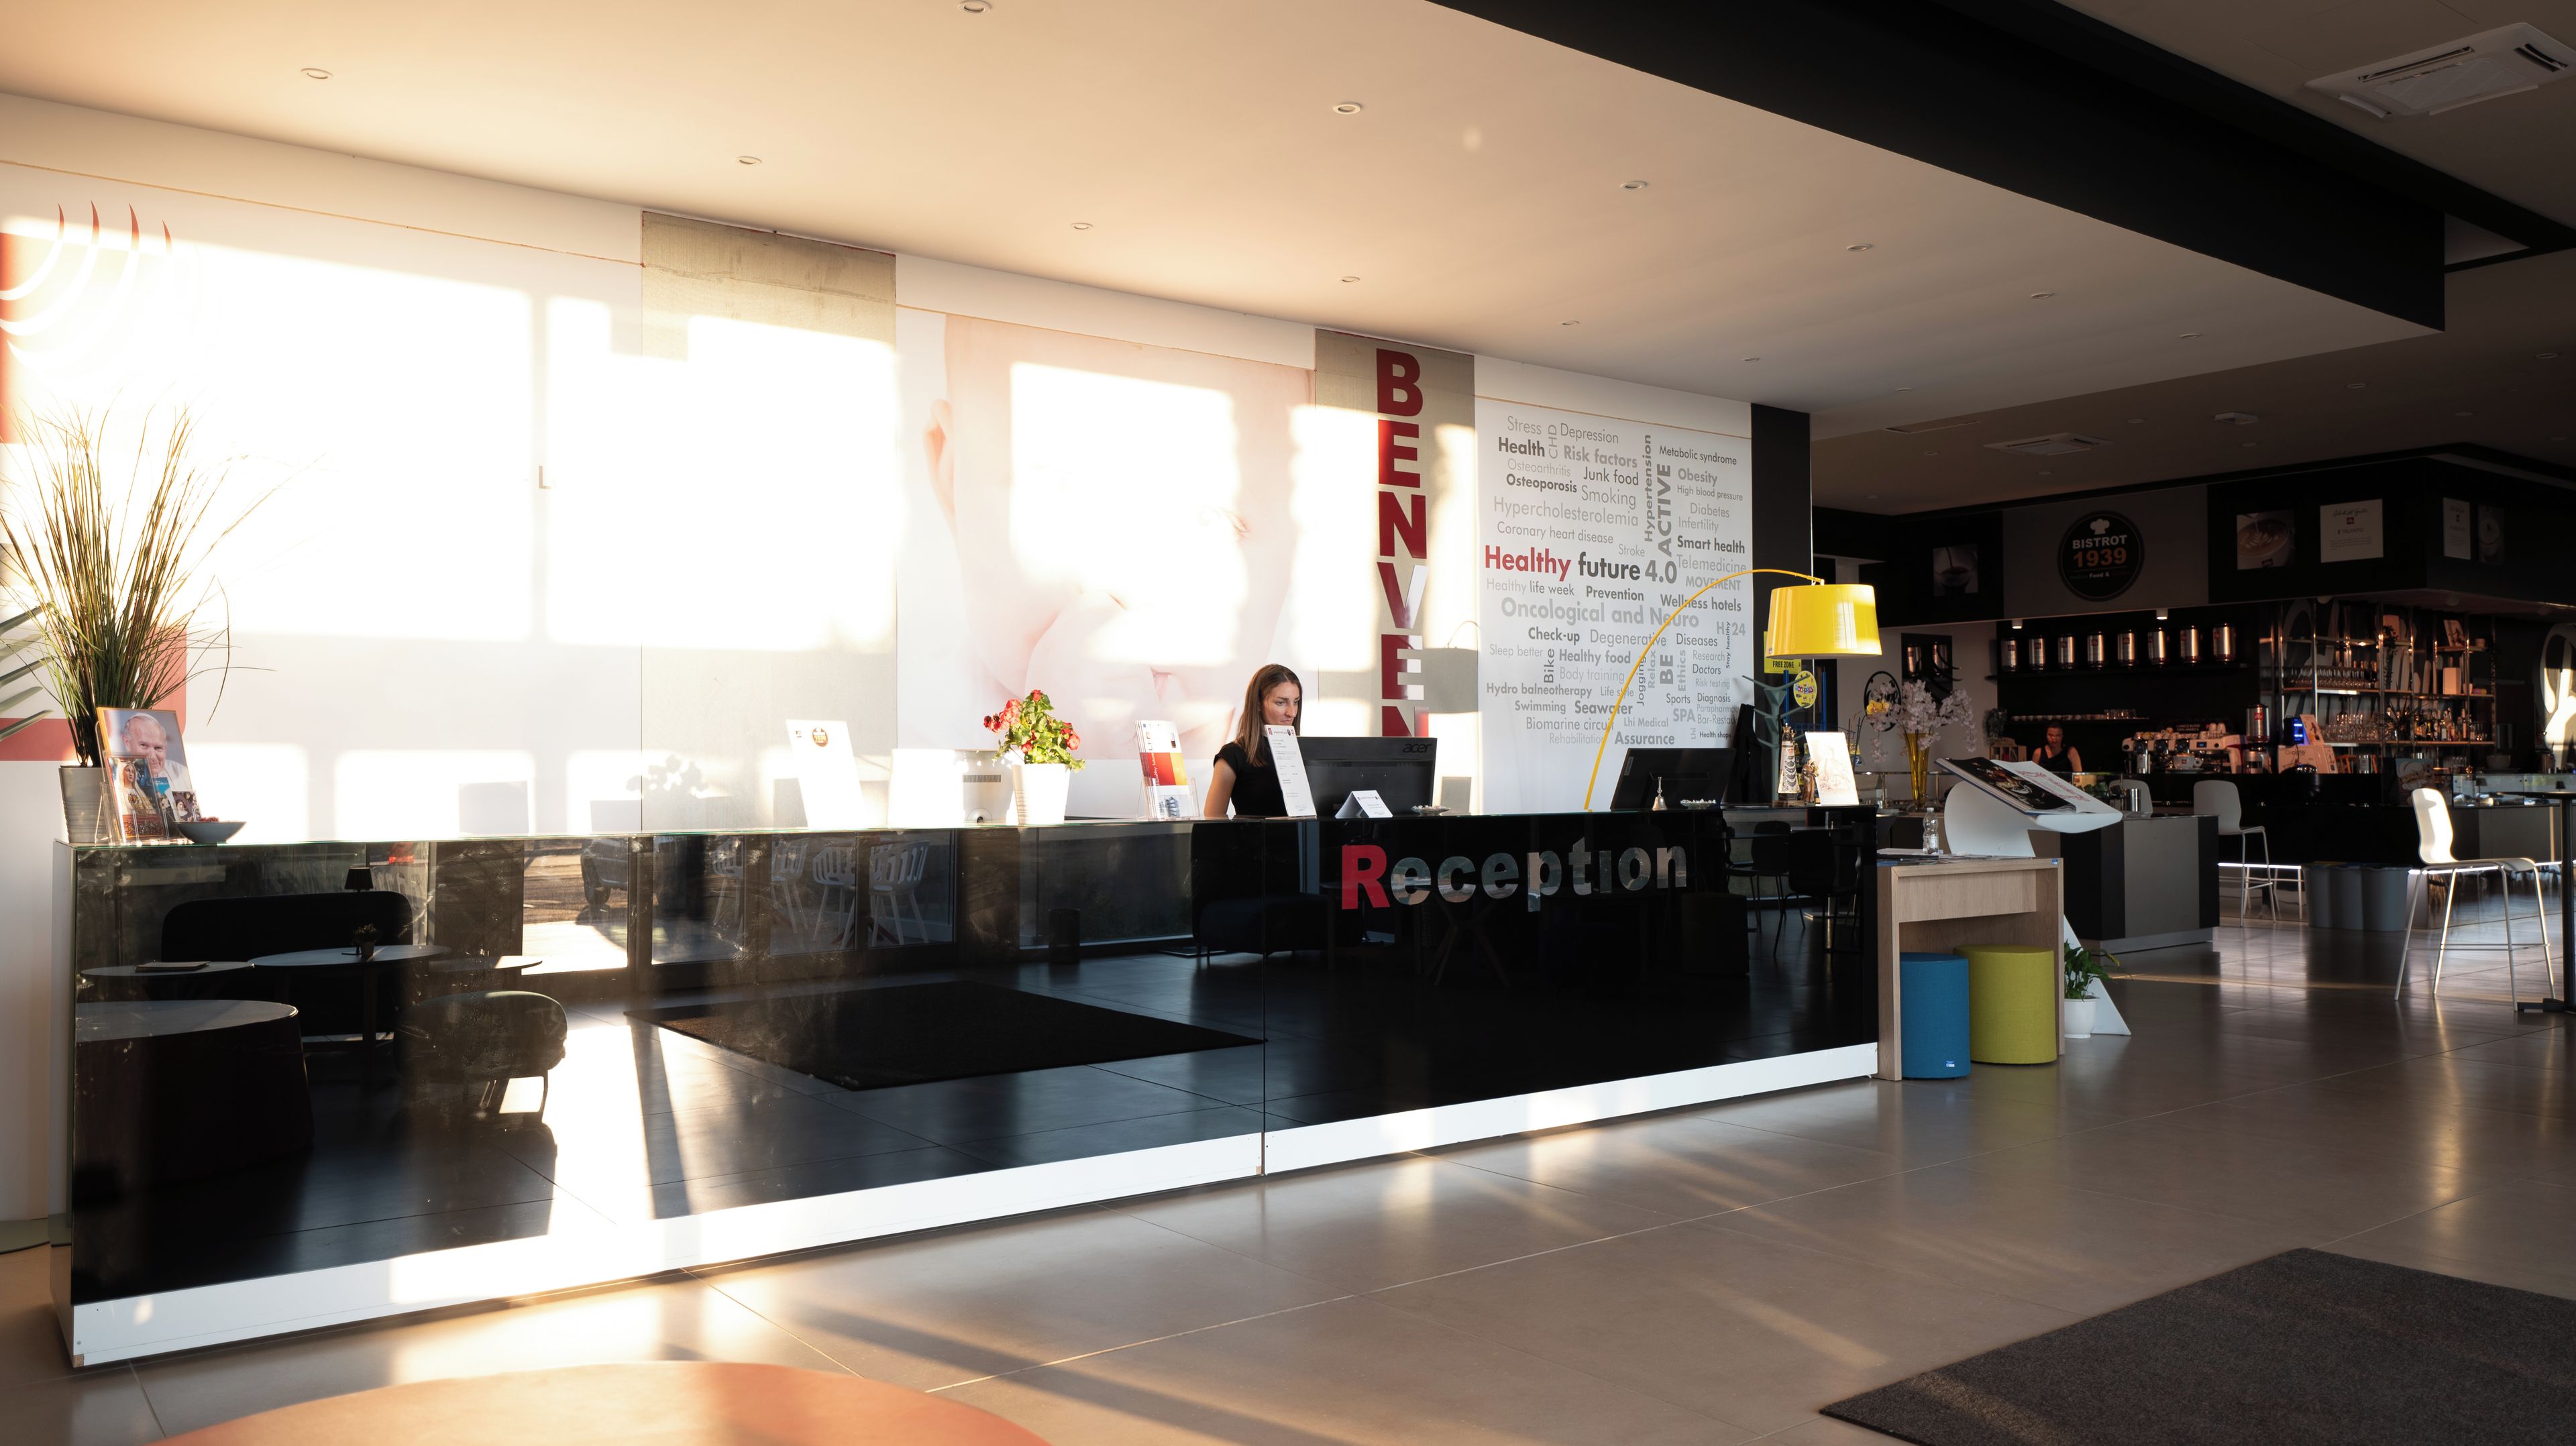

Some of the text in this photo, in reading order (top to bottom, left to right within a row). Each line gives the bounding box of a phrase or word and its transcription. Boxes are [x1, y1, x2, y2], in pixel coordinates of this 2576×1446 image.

[1507, 416, 1542, 435] Stress
[1560, 423, 1618, 444] Depression
[1499, 437, 1545, 457] Health
[1548, 425, 1558, 459] CHD
[1564, 445, 1637, 468] Risk factors
[1660, 445, 1737, 465] Metabolic syndrome
[1507, 458, 1570, 477] Osteoarthritis
[1583, 467, 1638, 486] Junk food
[1507, 474, 1577, 492] Osteoporosis
[1678, 468, 1717, 487] Obesity
[1582, 484, 1635, 510] Smoking
[1642, 435, 1656, 542] Hypertension
[1677, 484, 1743, 501] High blood pressure
[1494, 496, 1638, 526] Hypercholesterolemia
[1657, 464, 1672, 557] ACTIVE
[1690, 502, 1729, 518] Diabetes
[1497, 521, 1613, 544] Coronary heart disease
[1678, 517, 1719, 534] Infertility
[1618, 543, 1645, 557] Stroke
[1677, 535, 1744, 553] Smart health
[2072, 535, 2127, 549] BISTROT
[1485, 545, 1677, 583] Healthy future 4.0
[1676, 554, 1746, 573] Telemedicine
[2074, 547, 2126, 567] 1939
[1487, 577, 1574, 596] Healthy life week
[1587, 586, 1644, 601] Prevention
[1501, 597, 1605, 626] Oncological
[1611, 605, 1644, 624] and
[1711, 597, 1741, 612] hotels
[1528, 626, 1580, 645] Check-up
[1716, 622, 1746, 636] H 24
[1676, 633, 1717, 647] Diseases
[1490, 644, 1544, 659] Sleep better
[1559, 649, 1631, 667] Healthy food
[1693, 649, 1725, 661] Research
[1544, 649, 1554, 683] Bike
[1560, 667, 1625, 683] Body training
[1648, 651, 1656, 688] Relax
[1660, 655, 1673, 684] BE
[1677, 649, 1686, 692] Ethics
[1693, 664, 1721, 675] Doctors
[1487, 682, 1593, 699] Hydro balneotherapy
[1601, 687, 1614, 698] Life
[1696, 679, 1730, 688] Risk testing
[1666, 693, 1690, 706] Sports
[1697, 693, 1731, 704] Diagnosis
[1515, 701, 1566, 715] Swimming
[1673, 708, 1696, 722] SPA
[1697, 704, 1739, 714] Parapharmac
[1527, 718, 1614, 731] Biomarine circut
[1623, 717, 1668, 727] Lhi Medical
[1550, 733, 1604, 744] Rehabilitatio
[1615, 731, 1674, 744] Assurance
[1717, 731, 1731, 739] shops
[1403, 743, 1432, 753] acer
[1342, 836, 1686, 912] Reception
